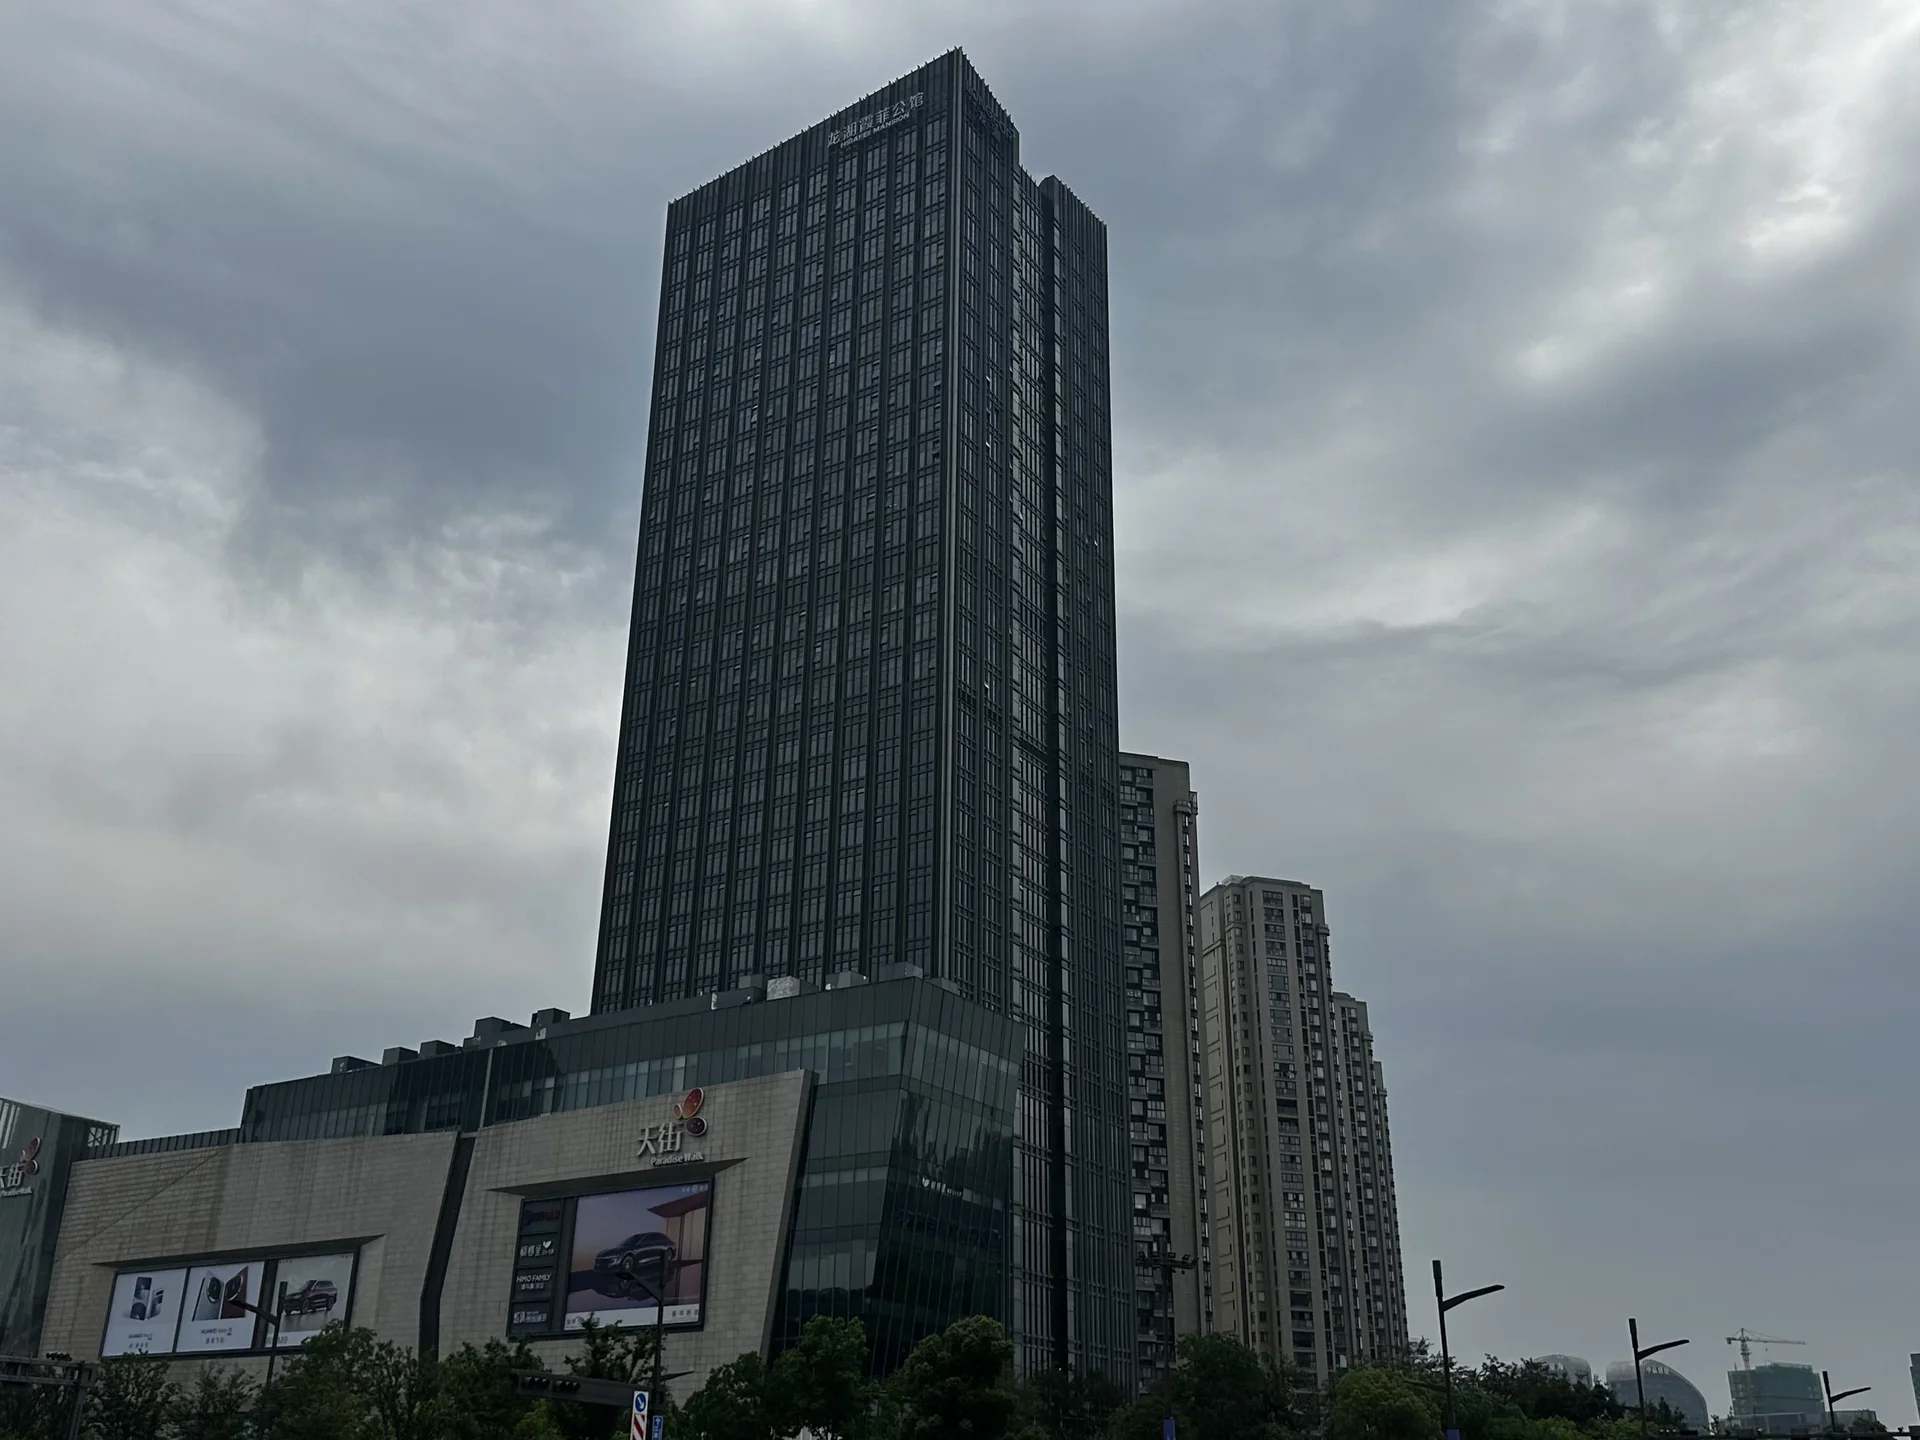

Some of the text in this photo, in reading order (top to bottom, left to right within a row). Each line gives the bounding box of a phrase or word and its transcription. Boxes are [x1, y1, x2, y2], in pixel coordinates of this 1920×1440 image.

[873, 111, 911, 134] MANSION
[637, 1122, 682, 1156] 天街
[651, 1151, 704, 1166] Paradise Walk
[516, 1273, 552, 1284] HIMO FAMILY
